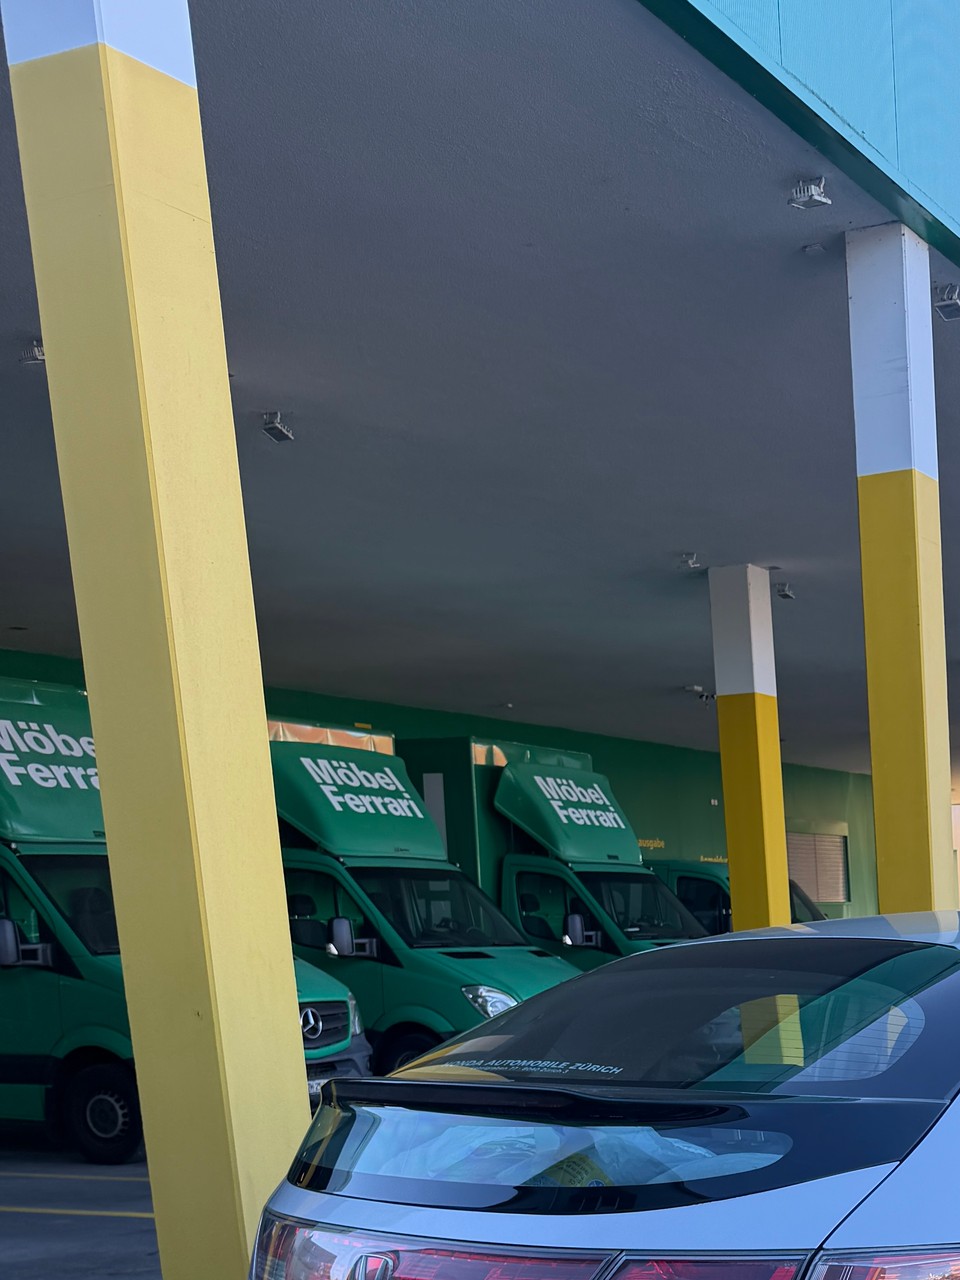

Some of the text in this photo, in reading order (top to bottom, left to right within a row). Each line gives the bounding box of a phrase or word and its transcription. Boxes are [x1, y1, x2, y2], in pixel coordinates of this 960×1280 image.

[0, 719, 96, 758] Möbe
[0, 752, 100, 790] Ferr
[300, 757, 405, 791] Möbel
[320, 784, 424, 819] Ferrari
[534, 775, 611, 806] Möbel
[550, 800, 626, 829] Ferrari
[638, 838, 665, 849] ausgabe
[484, 1060, 570, 1069] AUTOMOBILE
[569, 1061, 624, 1075] ZÜRICH
